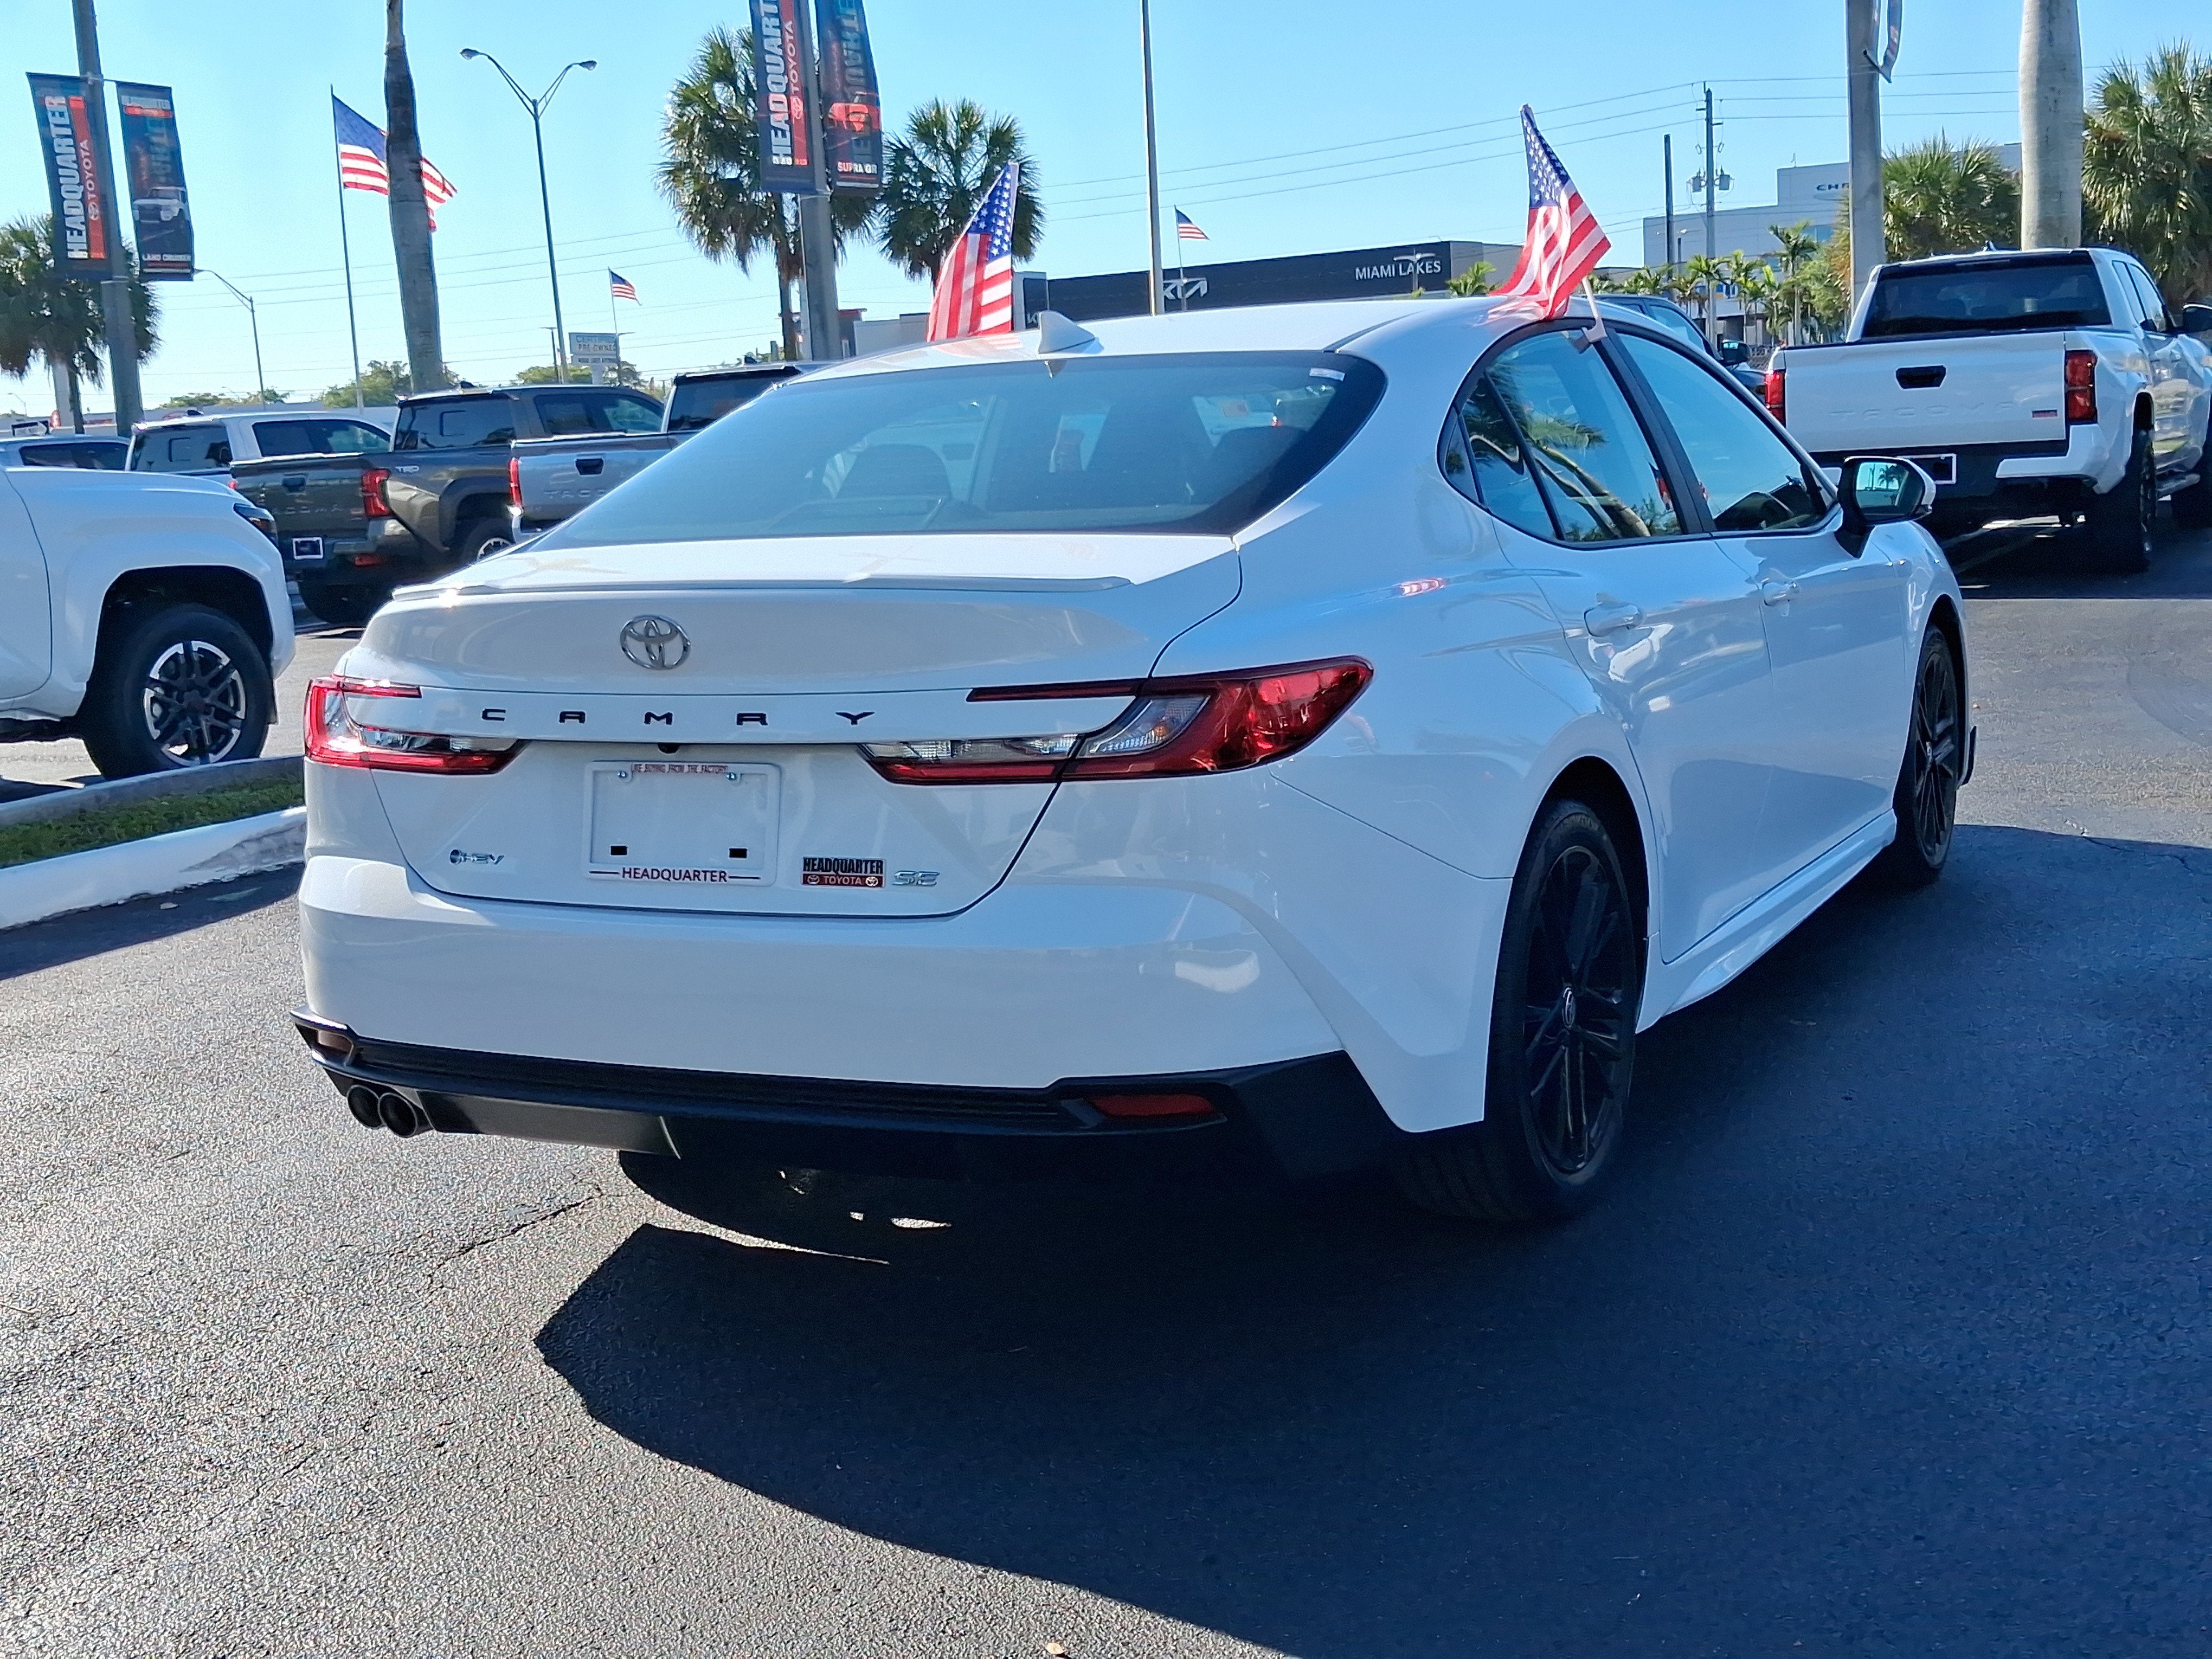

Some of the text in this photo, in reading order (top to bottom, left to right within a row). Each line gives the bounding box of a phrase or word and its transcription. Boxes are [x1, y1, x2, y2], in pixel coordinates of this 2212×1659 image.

[785, 21, 800, 94] TOYOTA
[759, 0, 792, 165] HEADQUART
[79, 139, 97, 200] TOYOTA
[838, 162, 864, 173] SUPRA
[44, 95, 88, 259] HEADQUARTER
[1355, 261, 1441, 280] MIAMI LAKES
[395, 465, 419, 473] TRD
[481, 708, 875, 726] CAMRY
[622, 867, 728, 882] HEADQUARTER
[803, 860, 884, 875] HEADQUARTER
[824, 876, 862, 885] TOYOTA
[892, 870, 941, 886] SE
